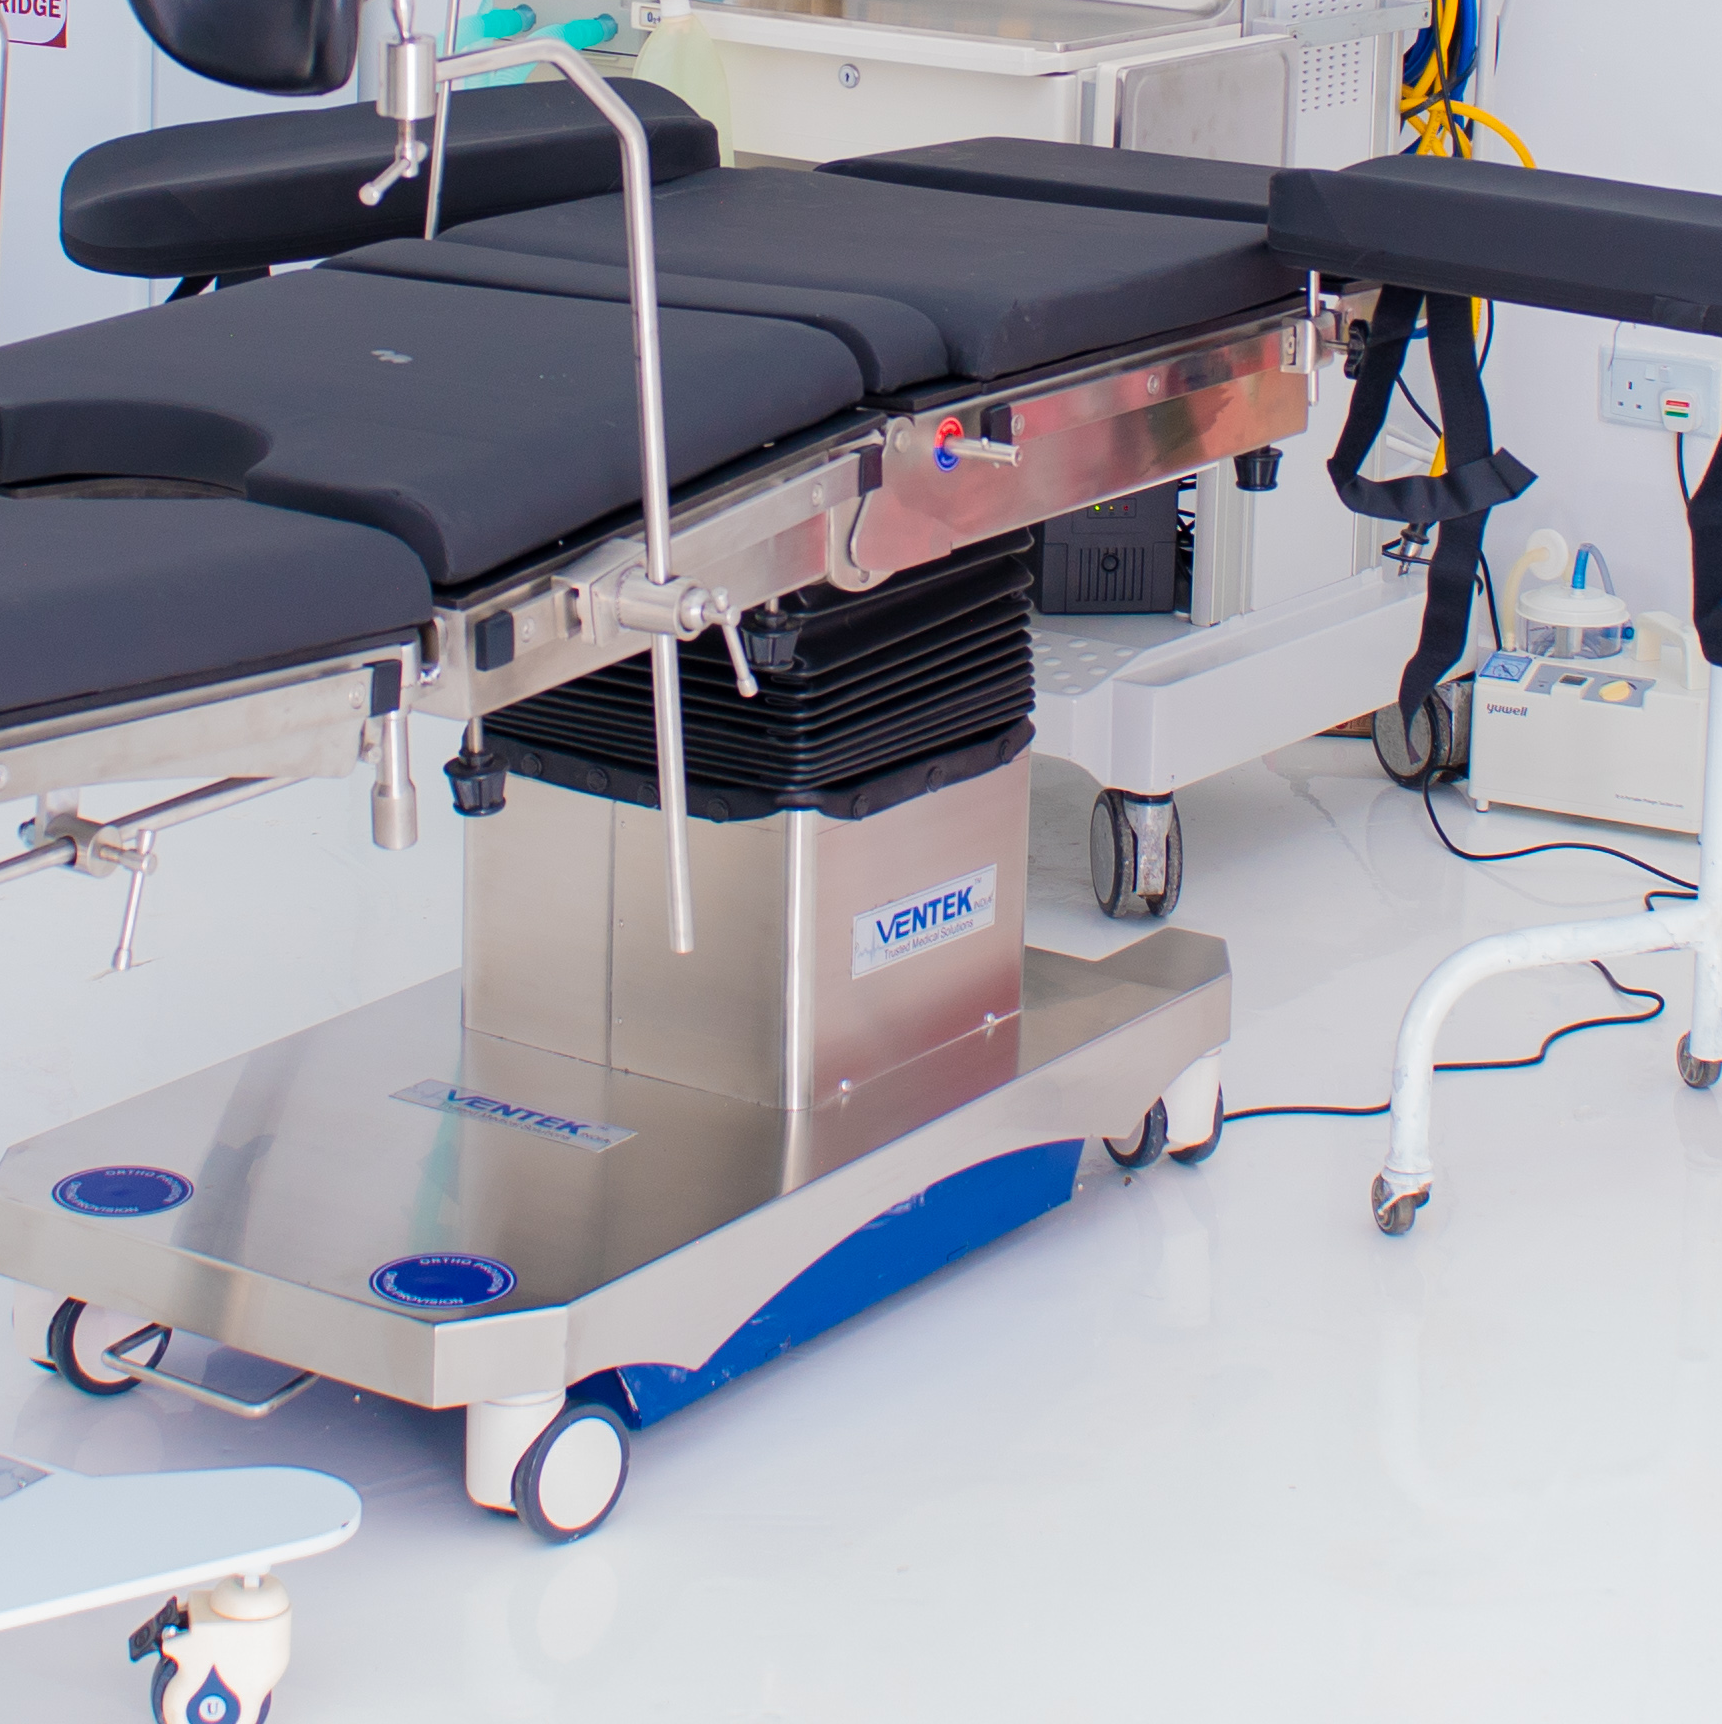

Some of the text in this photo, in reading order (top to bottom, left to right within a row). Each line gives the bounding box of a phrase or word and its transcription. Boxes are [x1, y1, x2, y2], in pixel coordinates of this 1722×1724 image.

[1486, 702, 1528, 718] yuwell
[876, 885, 974, 944] VENTEK
[884, 919, 974, 960] Trusted Medical Solutions
[447, 1089, 591, 1136] VENTEK
